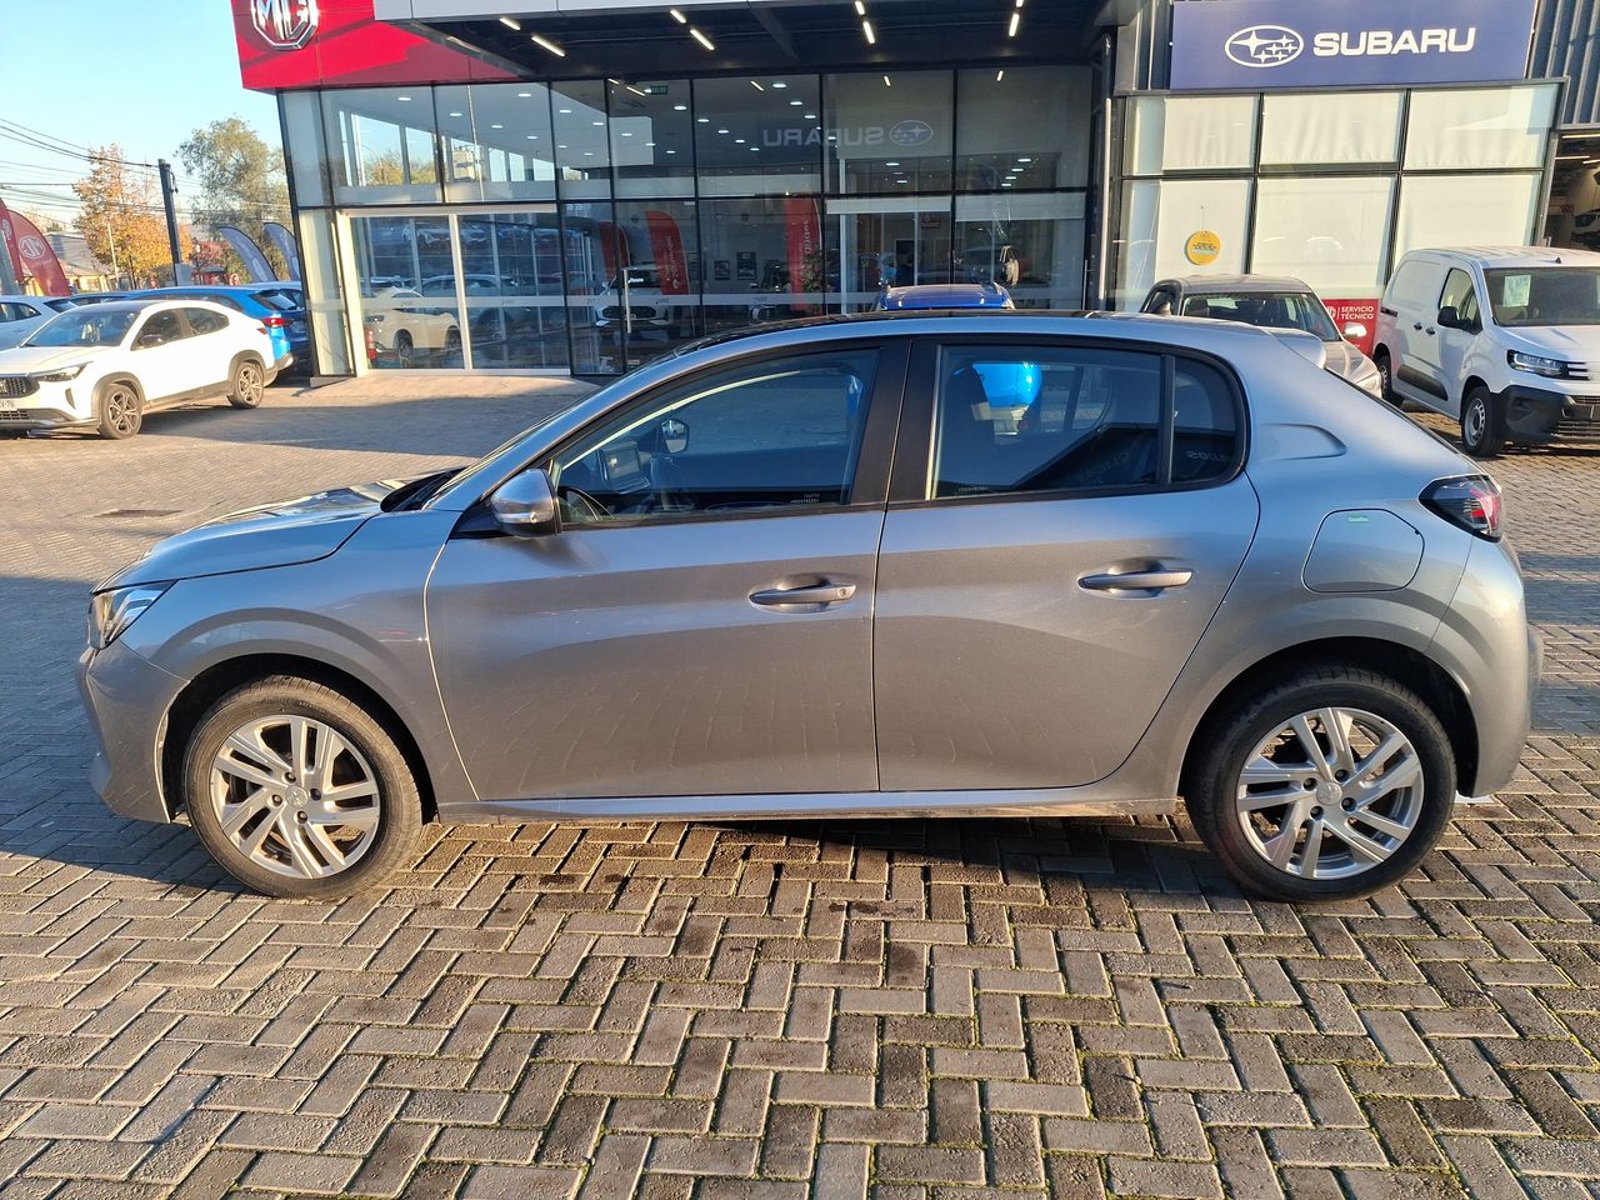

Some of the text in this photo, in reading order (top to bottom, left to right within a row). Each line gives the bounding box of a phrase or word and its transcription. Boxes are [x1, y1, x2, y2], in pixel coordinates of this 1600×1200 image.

[255, 0, 310, 41] MG
[1312, 26, 1476, 58] SUBARU
[1340, 305, 1374, 313] SERVICIO
[1340, 312, 1374, 320] TÉCNICO
